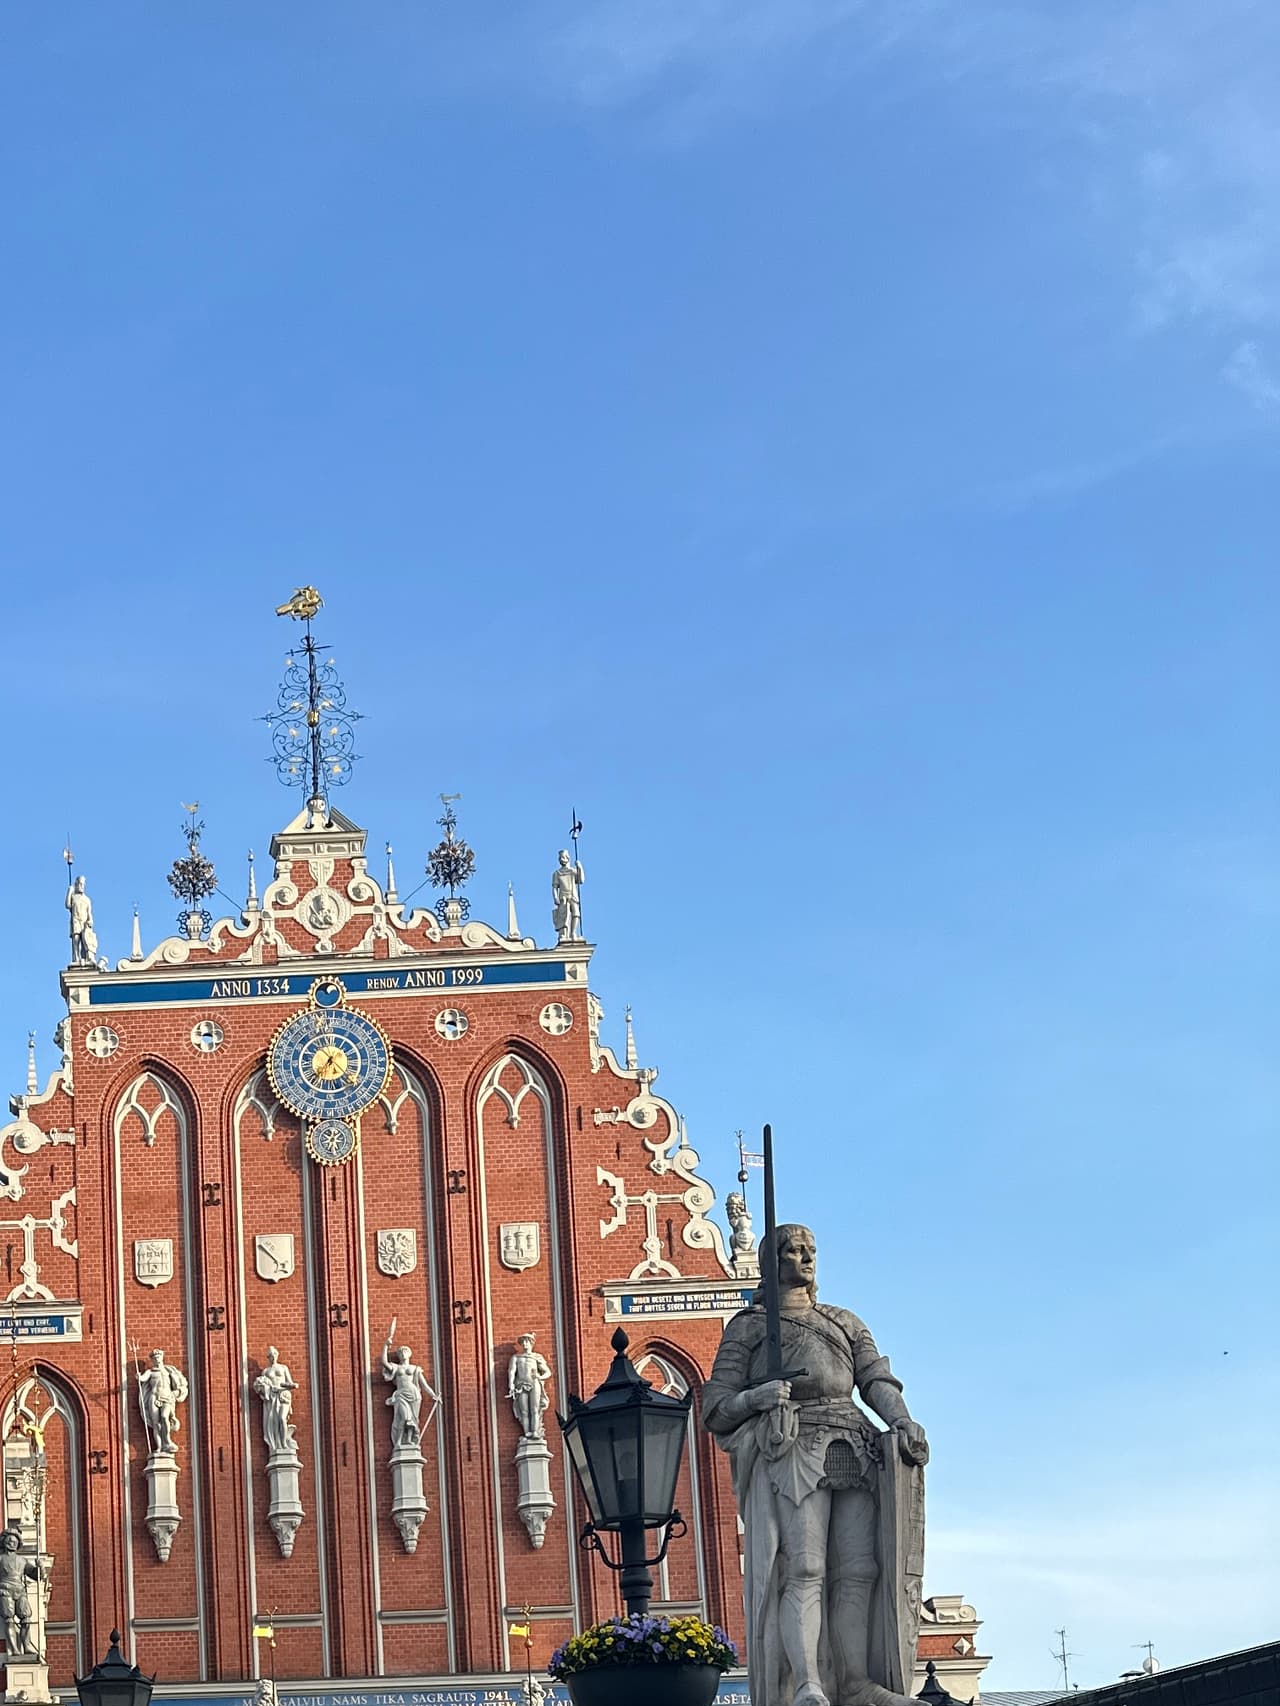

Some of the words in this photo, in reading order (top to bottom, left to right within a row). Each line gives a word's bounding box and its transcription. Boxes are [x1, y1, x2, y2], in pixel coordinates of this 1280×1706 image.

[211, 980, 251, 997] ANNO
[257, 978, 290, 995] 1334
[366, 977, 400, 990] RENOV.
[403, 970, 445, 988] ANNO
[452, 968, 483, 985] 1999
[332, 1695, 368, 1706] NAMS
[375, 1694, 405, 1705] TIKA
[412, 1692, 477, 1704] SAGRAUTS
